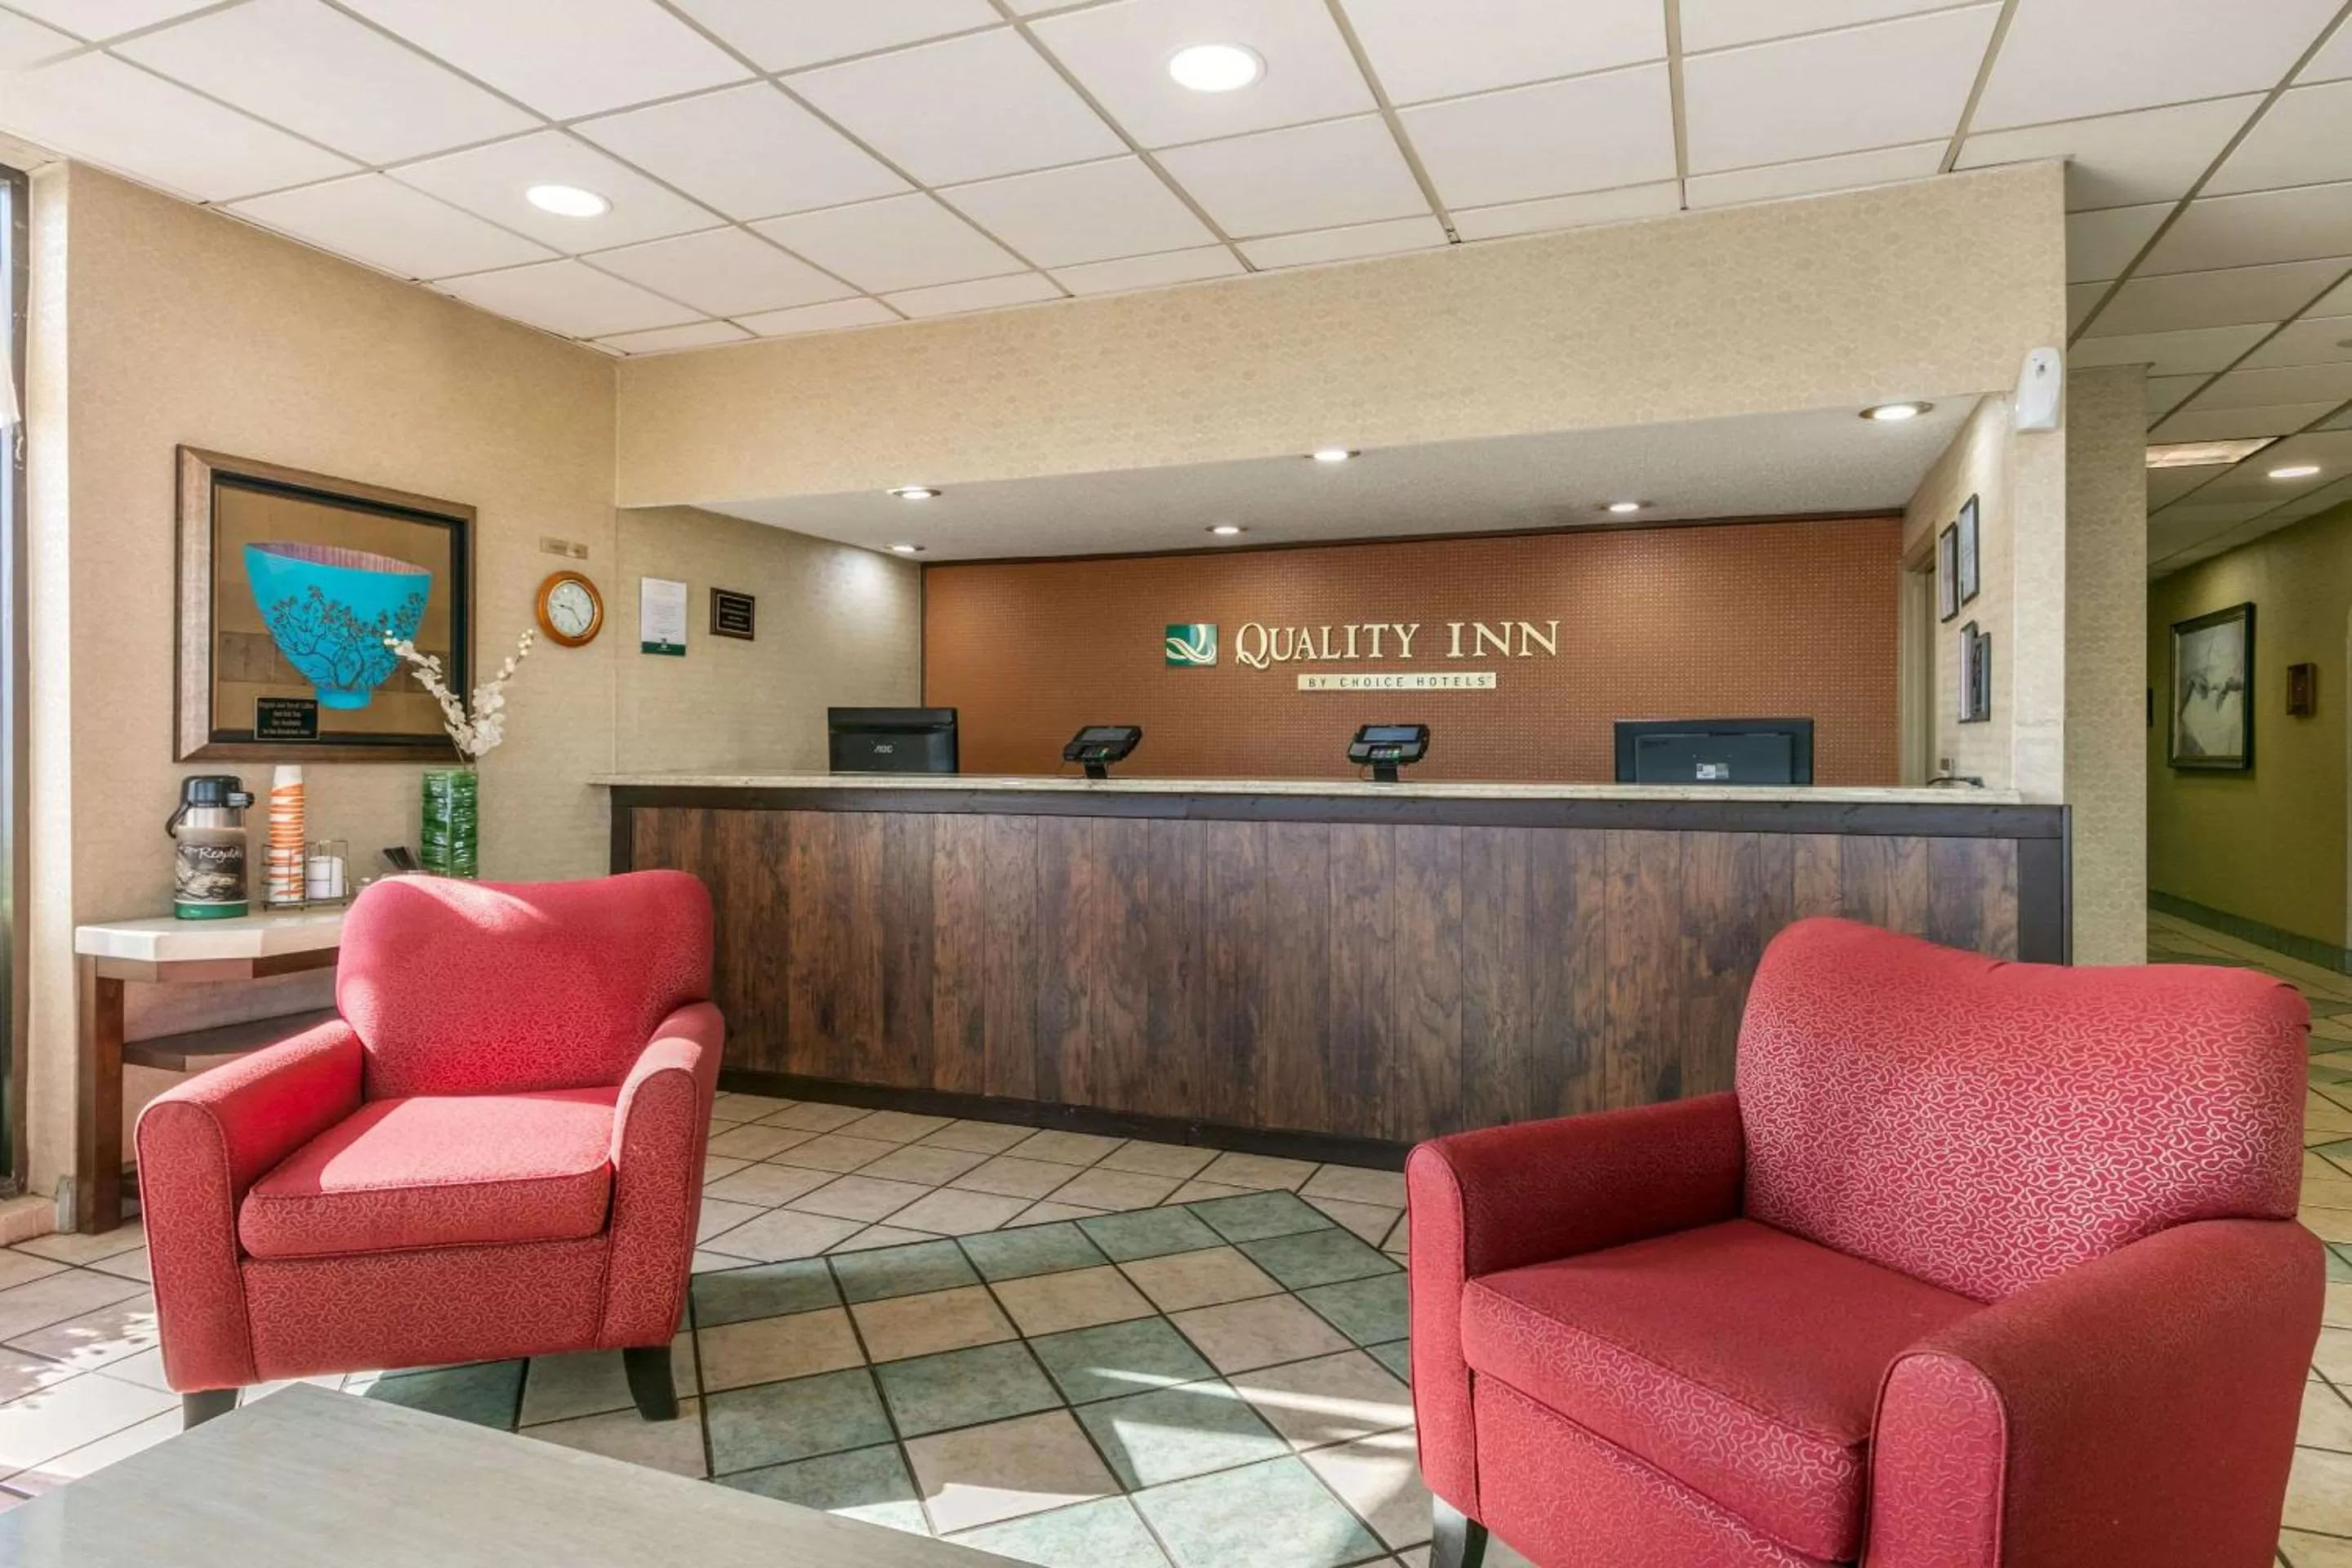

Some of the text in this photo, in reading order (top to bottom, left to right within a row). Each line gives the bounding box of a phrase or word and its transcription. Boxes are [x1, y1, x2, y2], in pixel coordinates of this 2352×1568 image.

[1235, 620, 1561, 670] QUALITY INN
[1308, 675, 1486, 688] BY CHOICE HOTELS
